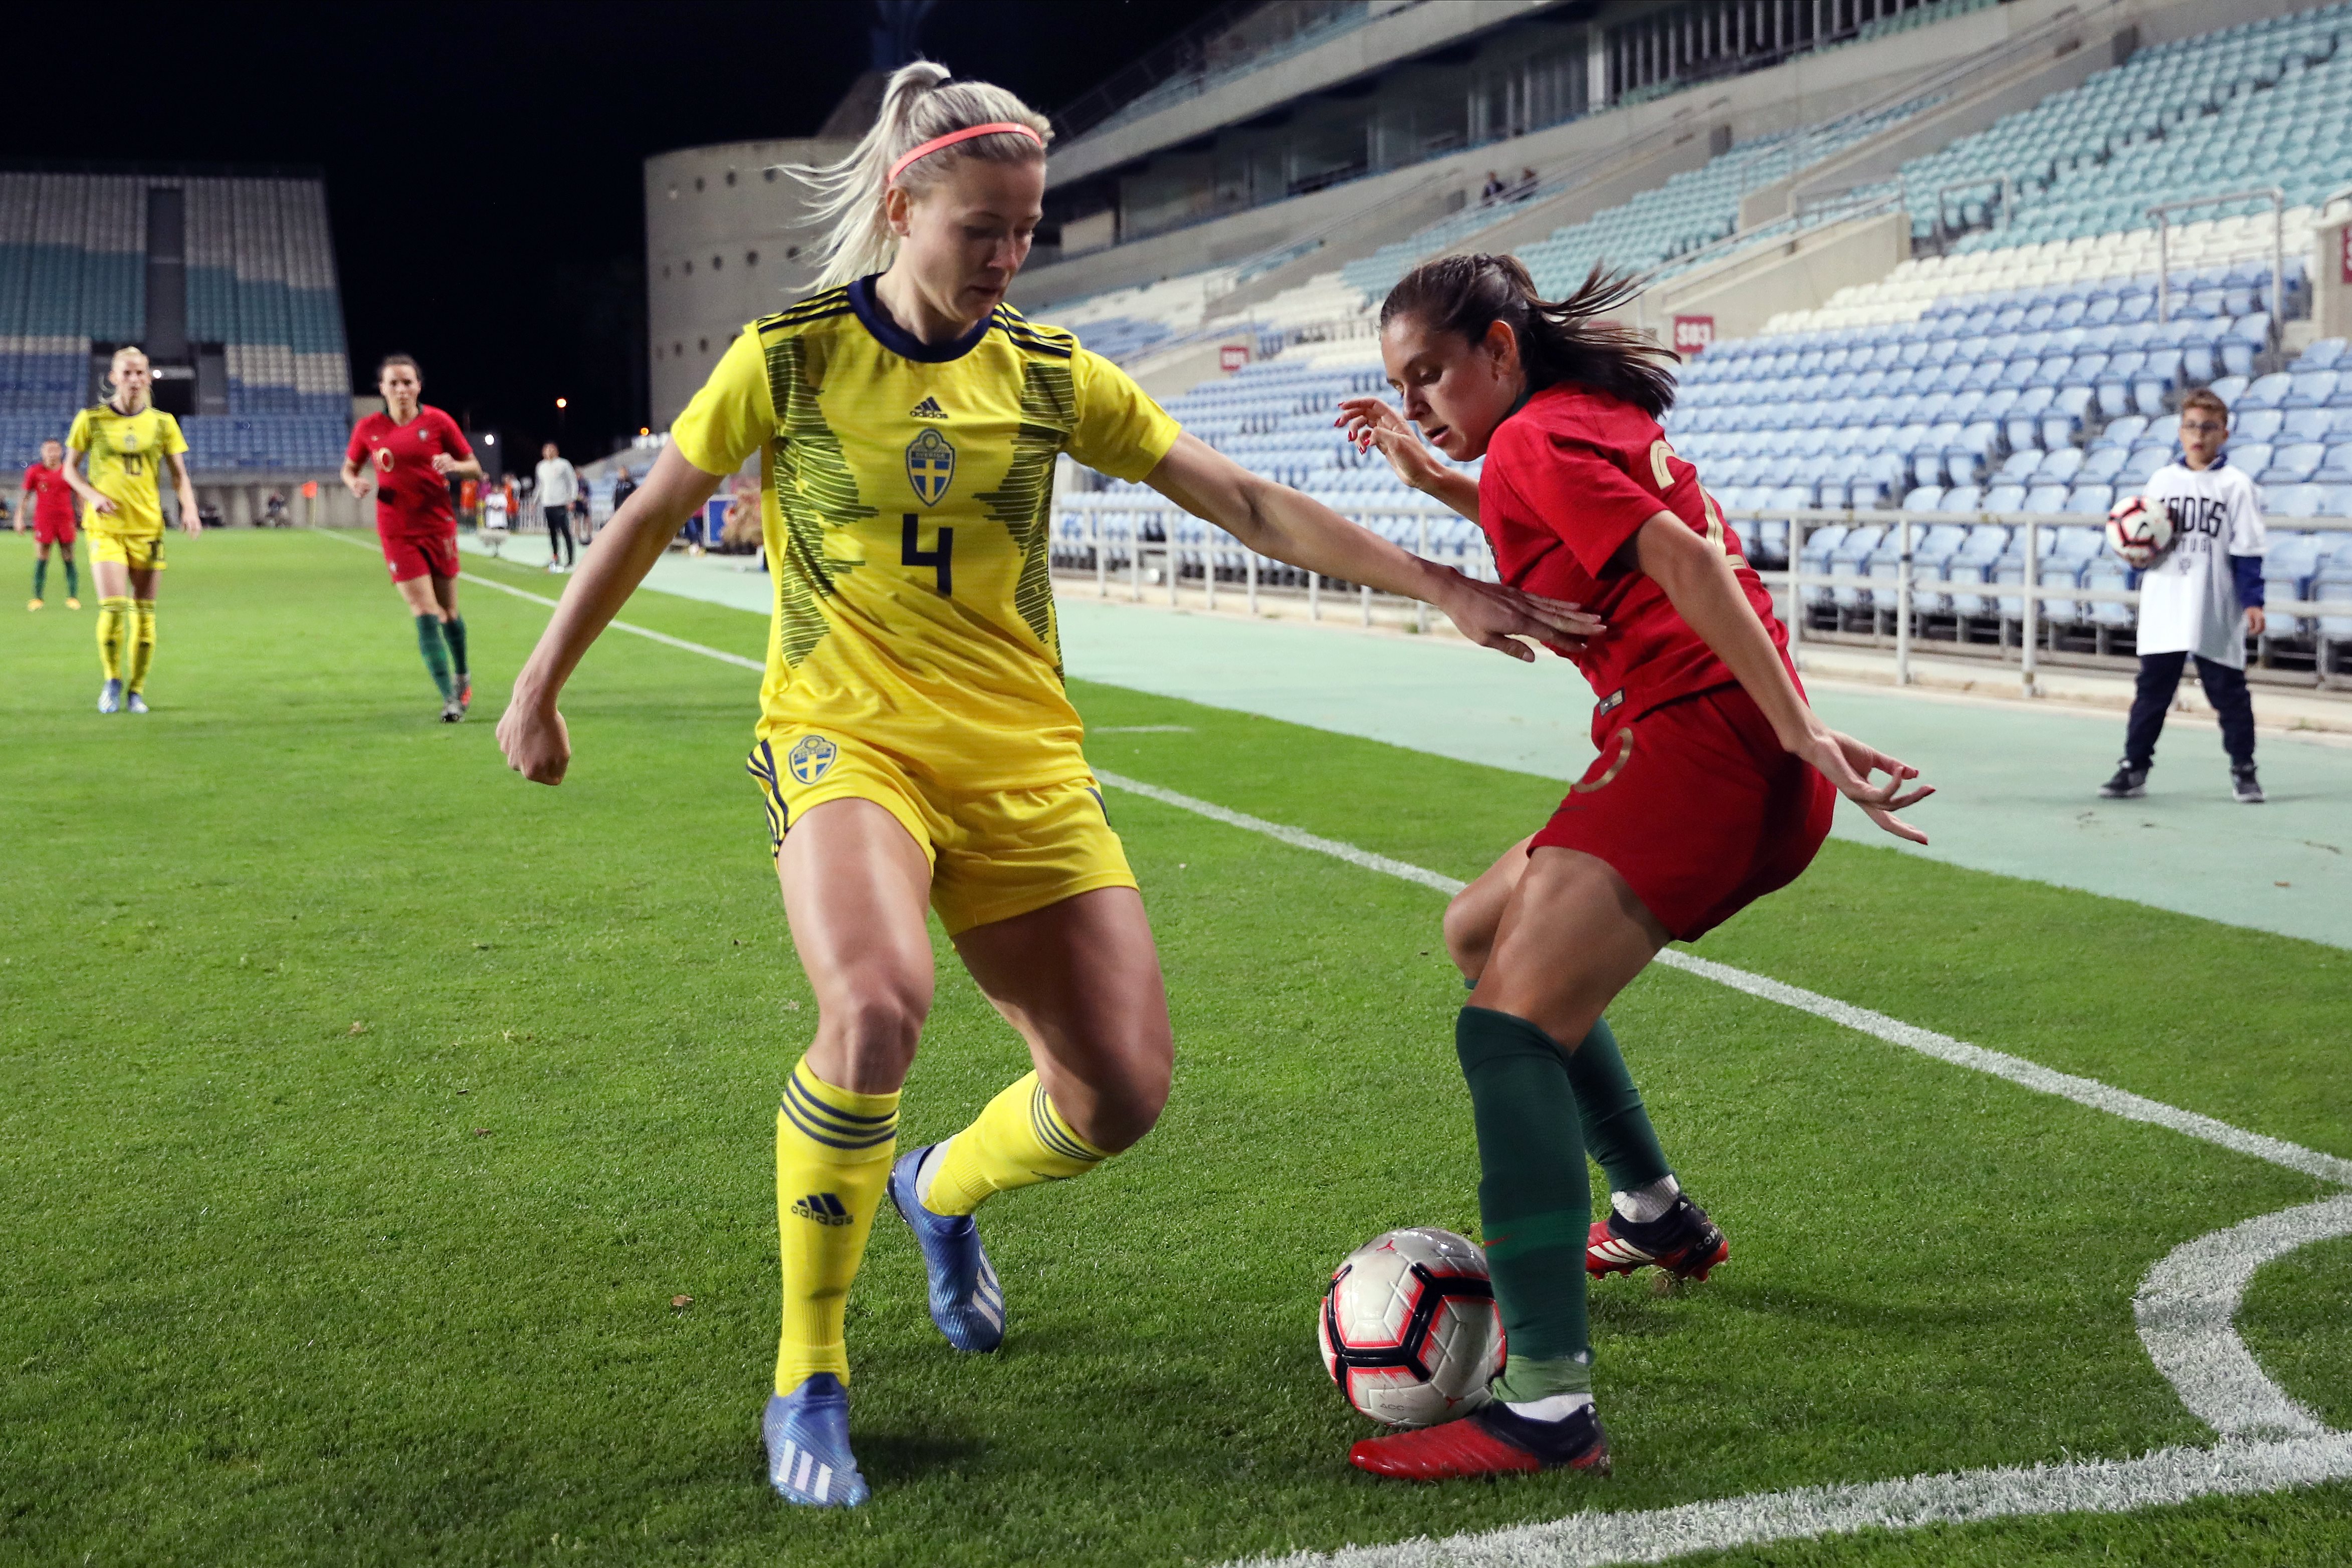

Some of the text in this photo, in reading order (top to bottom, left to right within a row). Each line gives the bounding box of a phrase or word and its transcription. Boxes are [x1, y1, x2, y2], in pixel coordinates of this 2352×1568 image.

[910, 410, 948, 418] adidas
[122, 452, 142, 476] 10
[902, 513, 953, 597] 4
[791, 1205, 853, 1226] adidas
[1380, 1403, 1404, 1411] ACC
